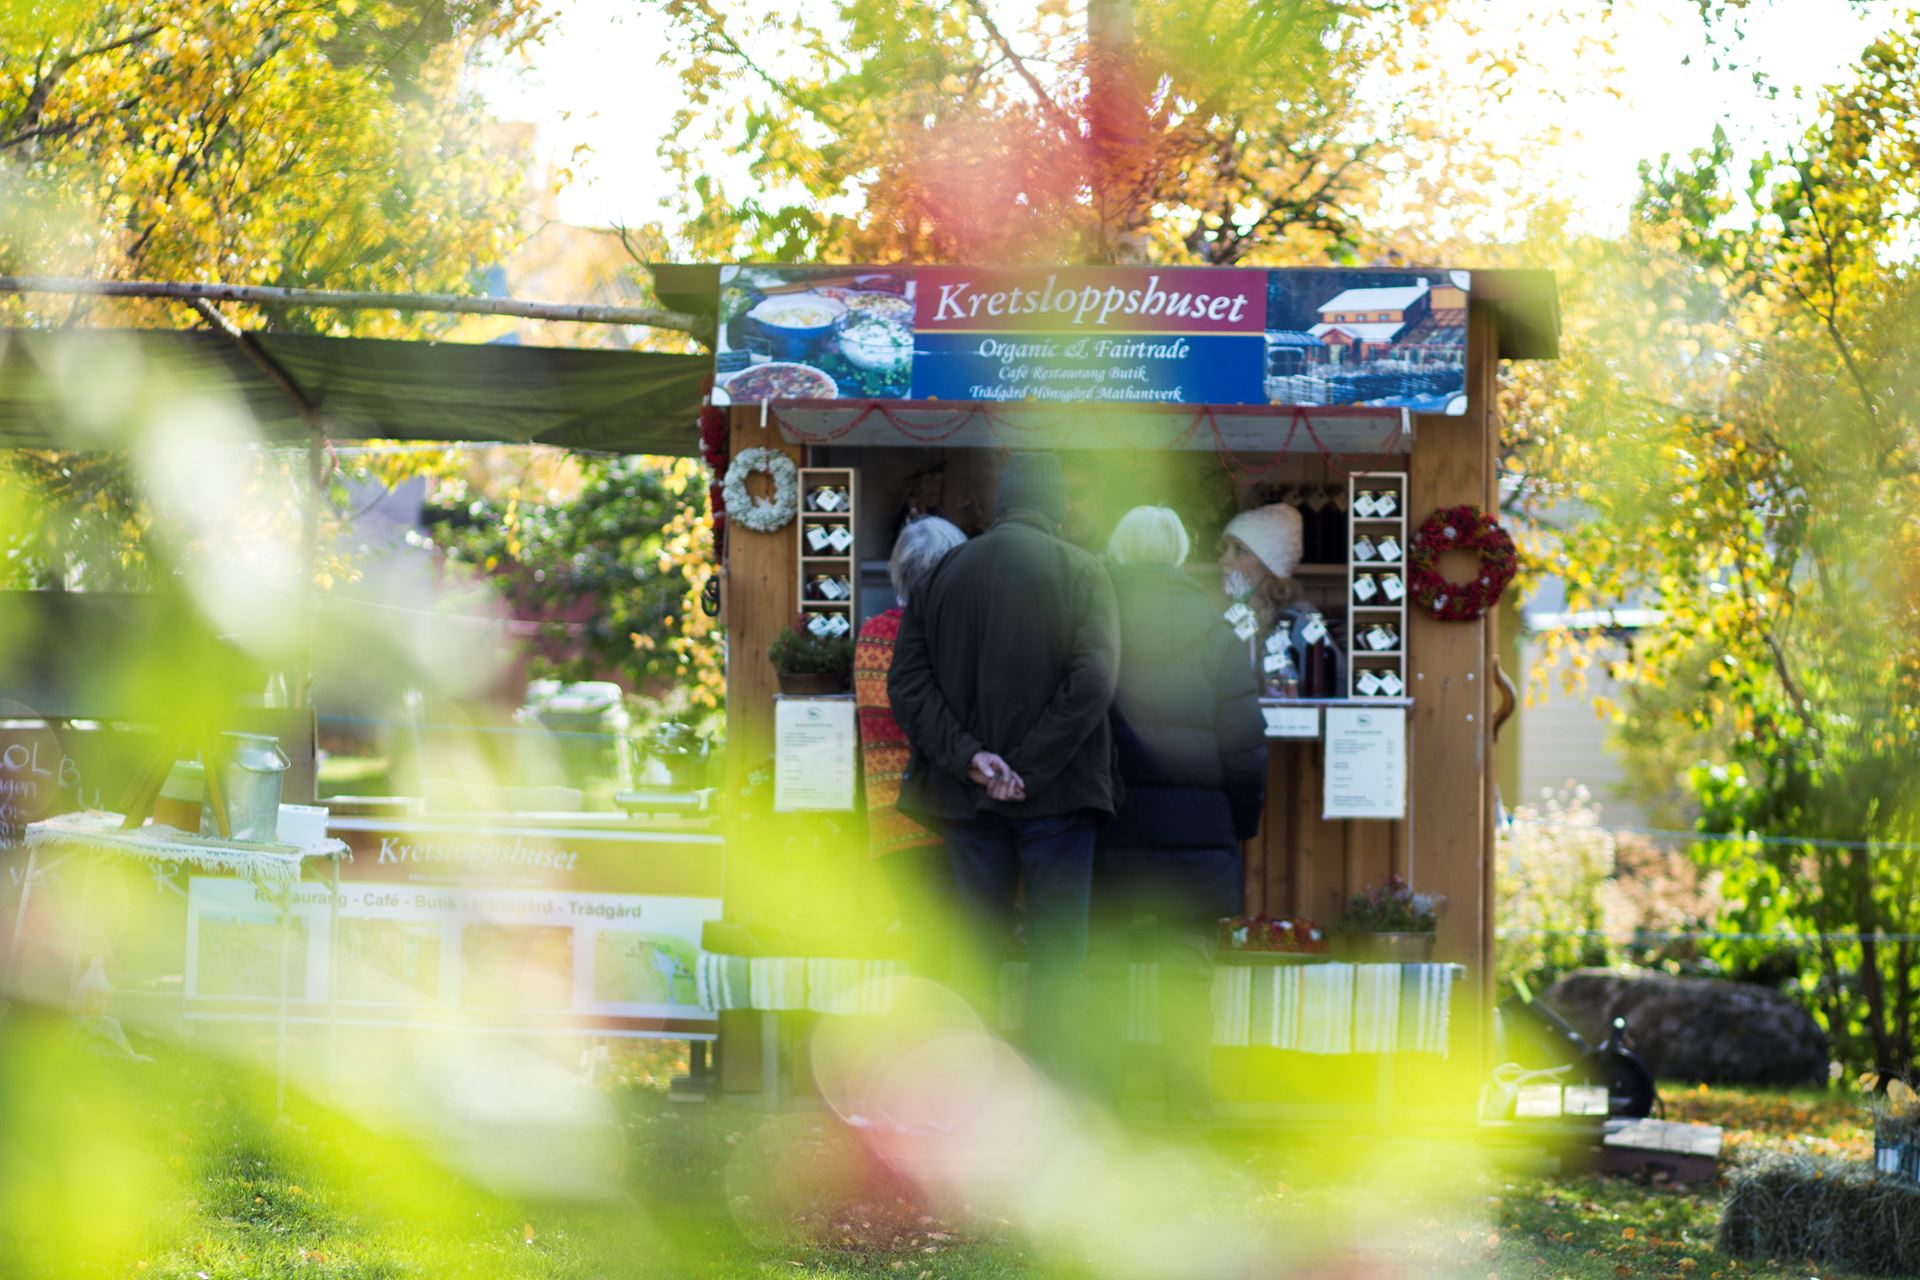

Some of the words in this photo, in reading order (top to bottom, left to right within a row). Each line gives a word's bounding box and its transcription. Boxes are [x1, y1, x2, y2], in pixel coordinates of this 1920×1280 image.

[932, 274, 1248, 325] Kretsloppshuset
[979, 338, 1060, 364] Organic
[1063, 337, 1090, 359] &
[1095, 337, 1190, 360] Fairtrade
[998, 365, 1028, 383] Café
[1109, 365, 1149, 382] Butik
[969, 384, 1028, 402] Trädgård
[1097, 386, 1184, 403] Mathantverk
[377, 836, 579, 872] Kretsloppshuset
[254, 888, 348, 909] Reaurag
[363, 891, 400, 908] Café
[415, 894, 457, 912] Butik
[569, 899, 642, 920] Trädgård
